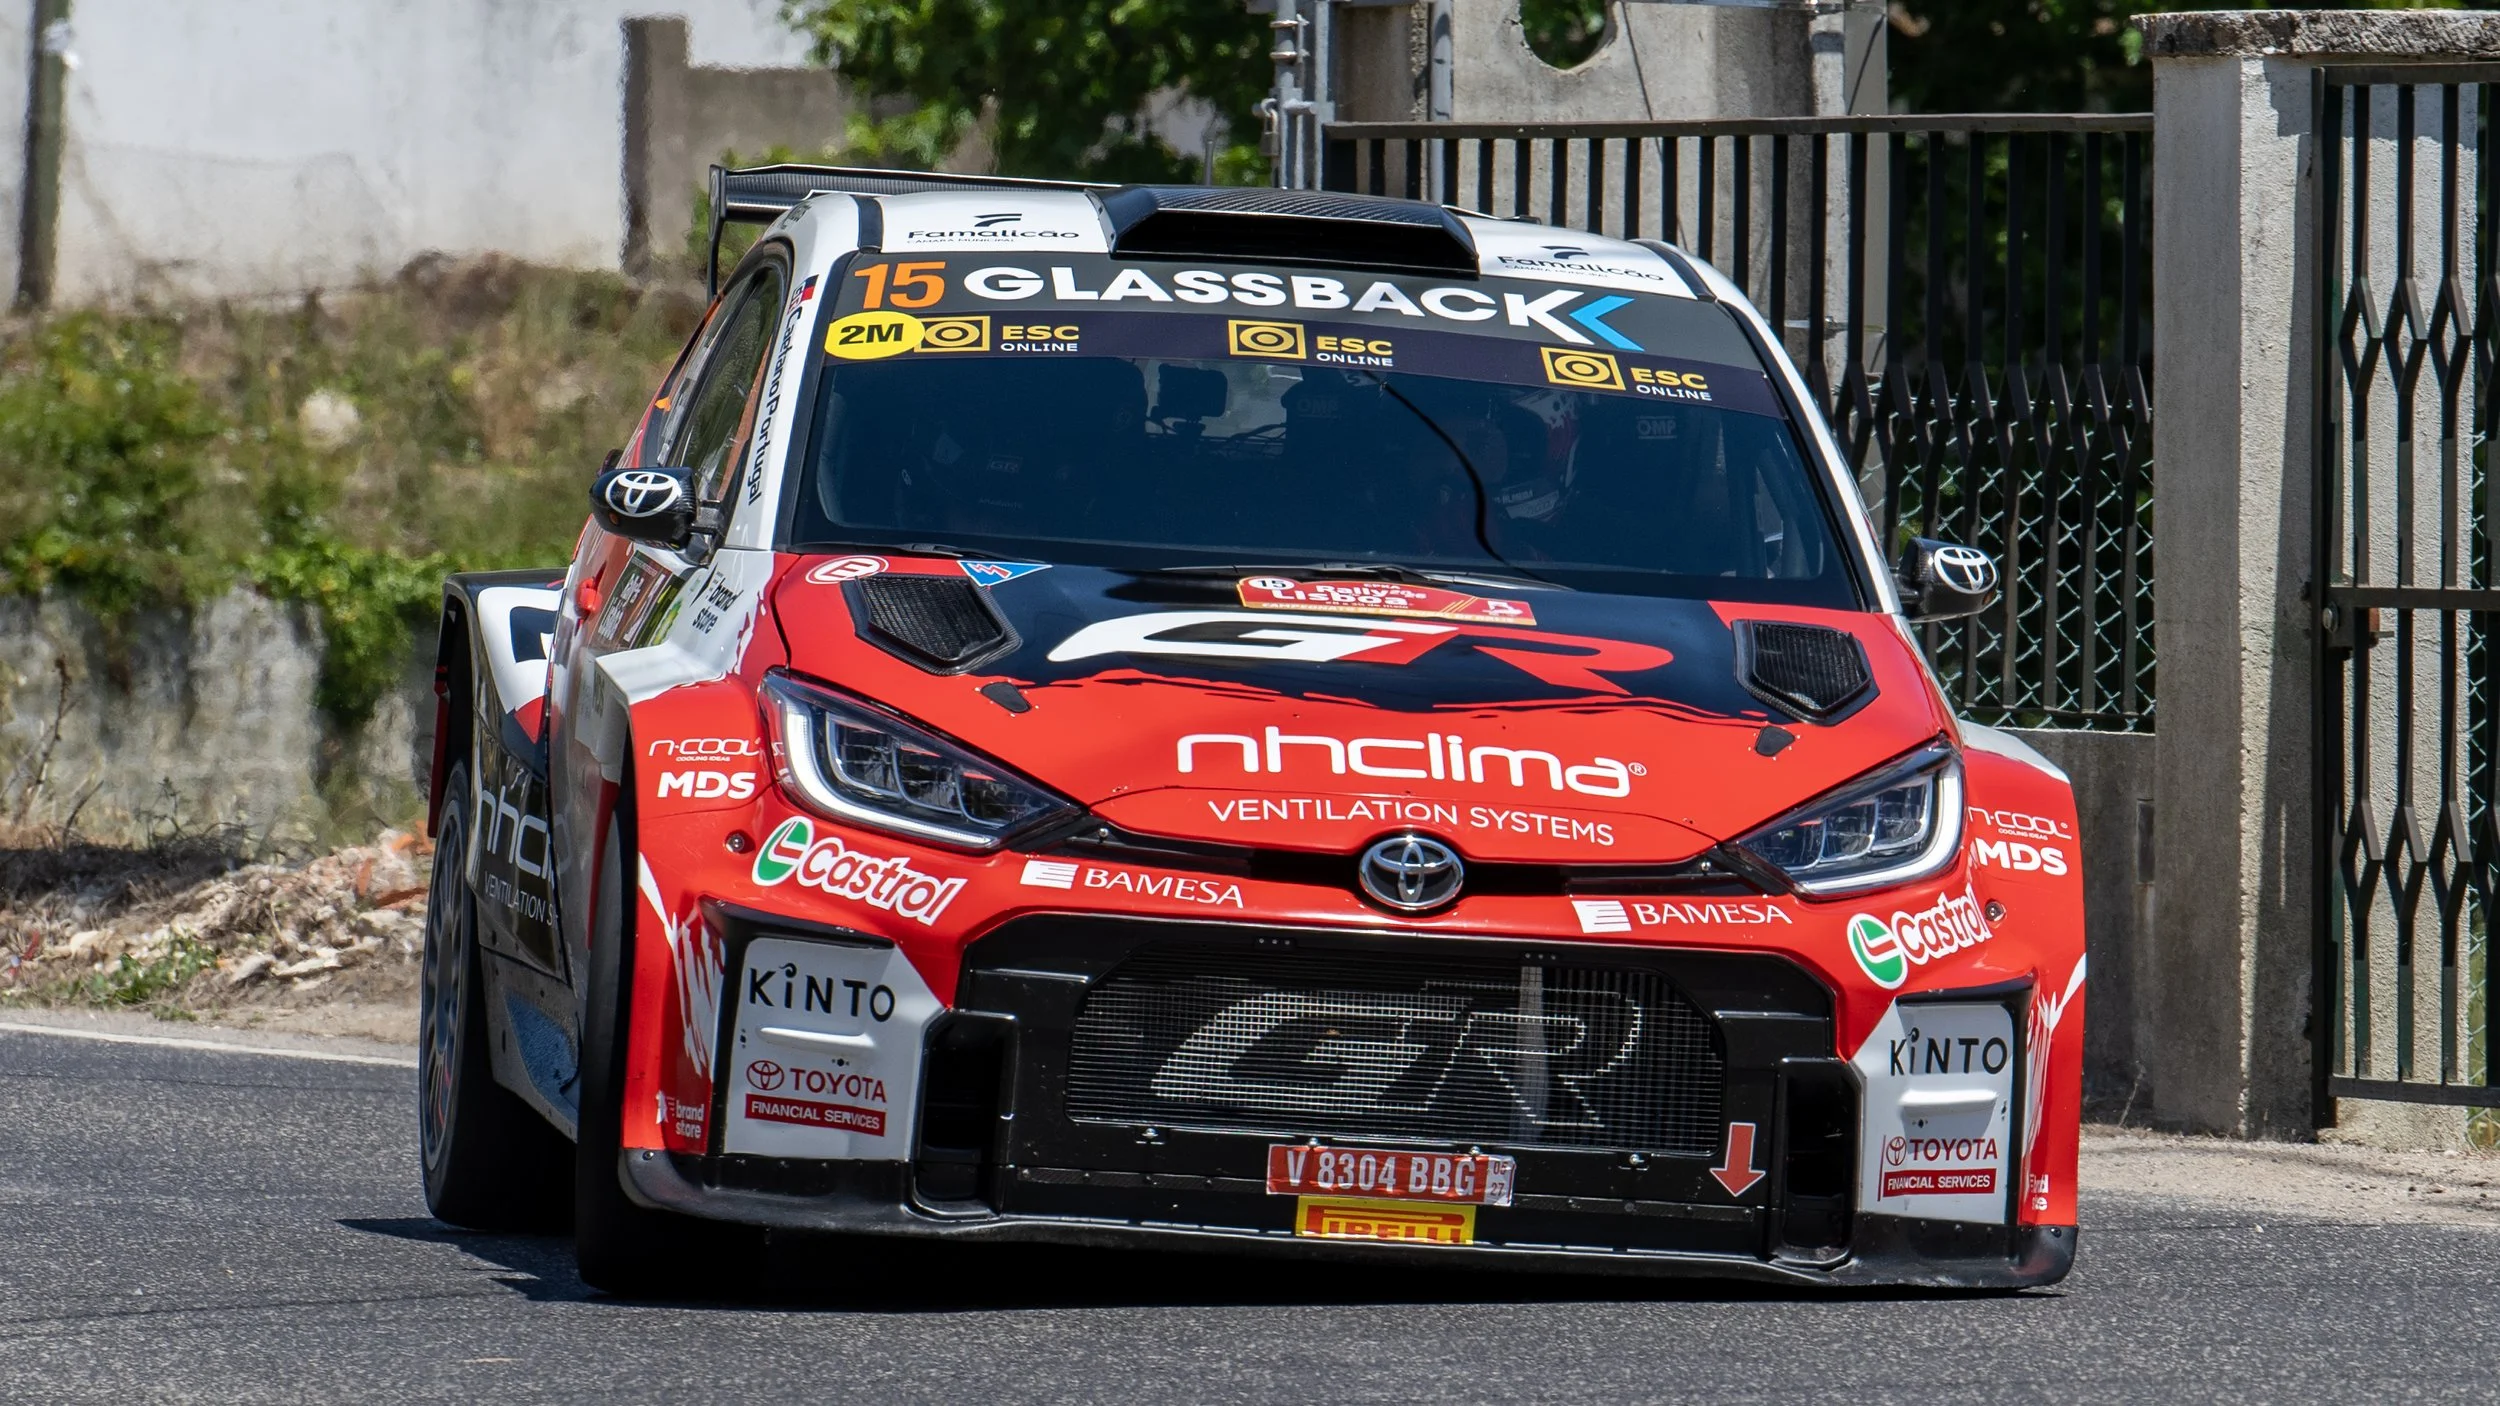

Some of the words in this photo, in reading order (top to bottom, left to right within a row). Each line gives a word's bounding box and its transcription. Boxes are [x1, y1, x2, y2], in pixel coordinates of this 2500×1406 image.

[907, 229, 1080, 239] Famalicão
[1497, 256, 1664, 281] Famalicão
[854, 261, 946, 309] 15
[964, 266, 1595, 346] GLASSBACK
[839, 322, 904, 346] 2M
[1002, 325, 1079, 341] ESC
[769, 306, 803, 397] Caetano
[1000, 342, 1078, 352] ONLINE
[1316, 336, 1392, 356] ESC
[1316, 353, 1394, 367] ONLINE
[1631, 367, 1708, 390] ESC
[1636, 384, 1712, 401] ONLINE
[748, 394, 781, 506] Portugal
[708, 577, 744, 612] brand
[1258, 579, 1285, 589] 15
[1316, 585, 1388, 597] Rally
[1273, 589, 1408, 606] Lisboa
[1047, 611, 1674, 696] GR
[657, 771, 756, 799] MDS
[1208, 798, 1458, 825] VENTILATION
[1470, 805, 1614, 847] SYSTEMS
[1974, 837, 2068, 876] MDS
[798, 838, 967, 925] Castrol
[1084, 867, 1244, 909] BAMESA
[484, 870, 546, 924] VENTILATION
[1630, 903, 1793, 925] BAMESA
[1892, 881, 1993, 965] Castrol
[790, 1067, 887, 1103] TOYOTA
[676, 1099, 704, 1122] brand
[751, 1101, 821, 1121] FINANCIAL
[824, 1111, 880, 1130] SERVICES
[676, 1120, 701, 1139] store
[1910, 1137, 1998, 1162] TOYOTA
[1286, 1150, 1306, 1187] V
[1317, 1151, 1396, 1194] 8304
[1408, 1156, 1476, 1197] BBG
[1887, 1177, 1934, 1190] FINANCIAL
[1937, 1174, 1991, 1190] SERVICES
[1490, 1182, 1505, 1196] 27
